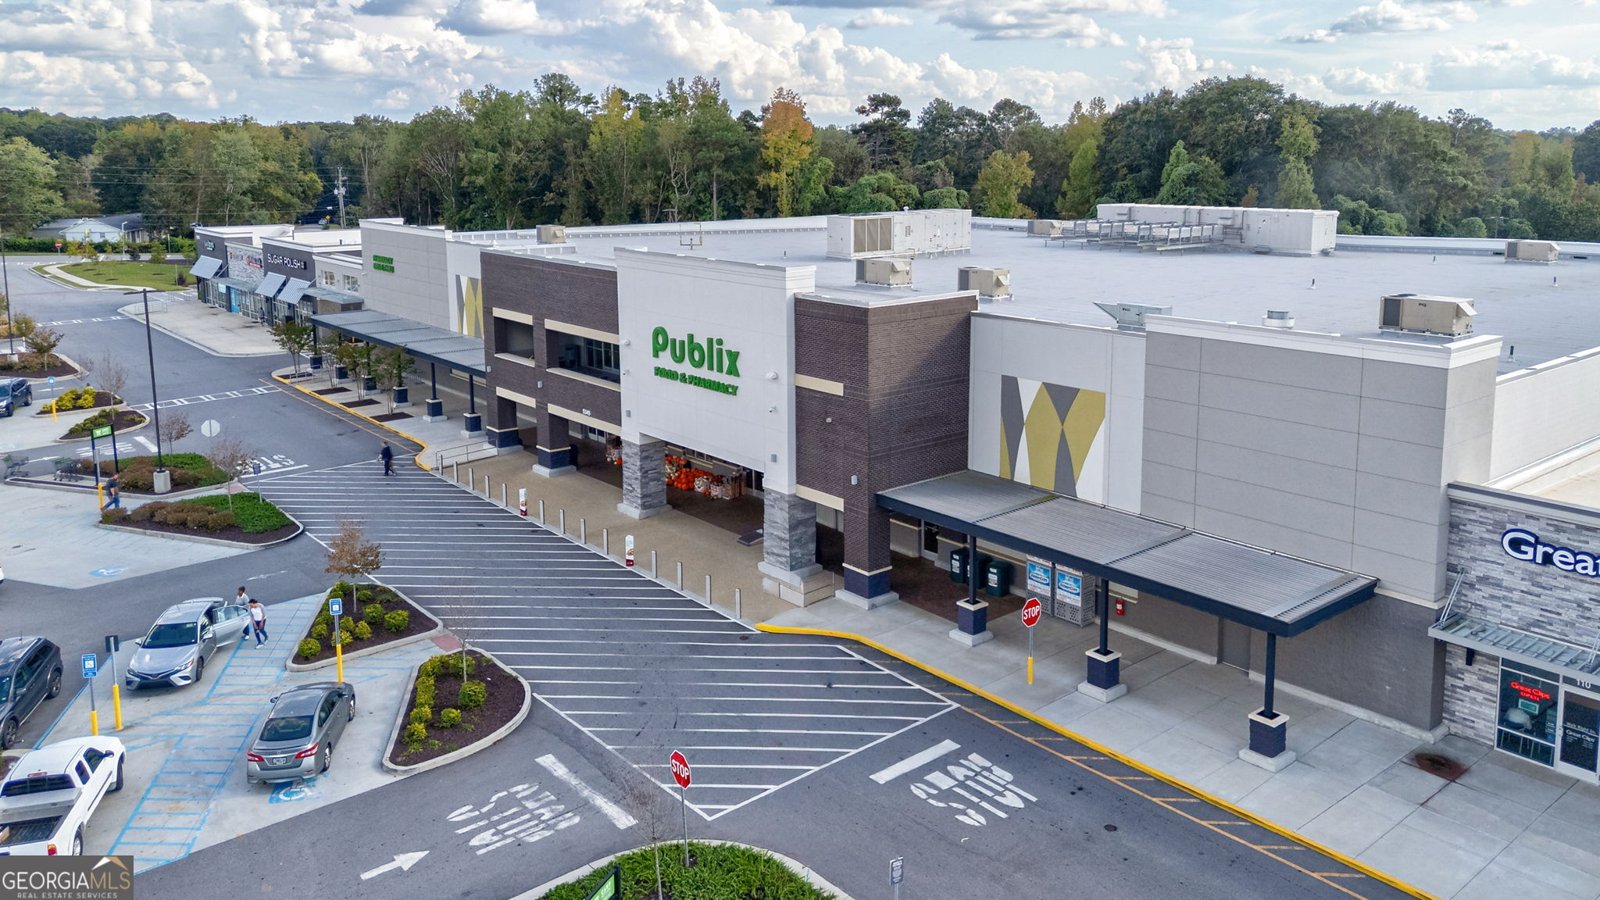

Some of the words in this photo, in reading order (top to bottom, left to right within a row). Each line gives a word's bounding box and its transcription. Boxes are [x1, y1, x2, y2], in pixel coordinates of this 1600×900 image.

[267, 253, 283, 265] SUGAR
[284, 256, 300, 269] POLISH
[652, 326, 740, 377] Publix
[654, 366, 679, 381] FOOD
[679, 372, 688, 384] &
[687, 374, 739, 396] PHARMACY
[1023, 605, 1040, 620] STOP
[1576, 678, 1592, 689] 110
[671, 758, 690, 780] STOP
[910, 752, 1038, 826] STOP
